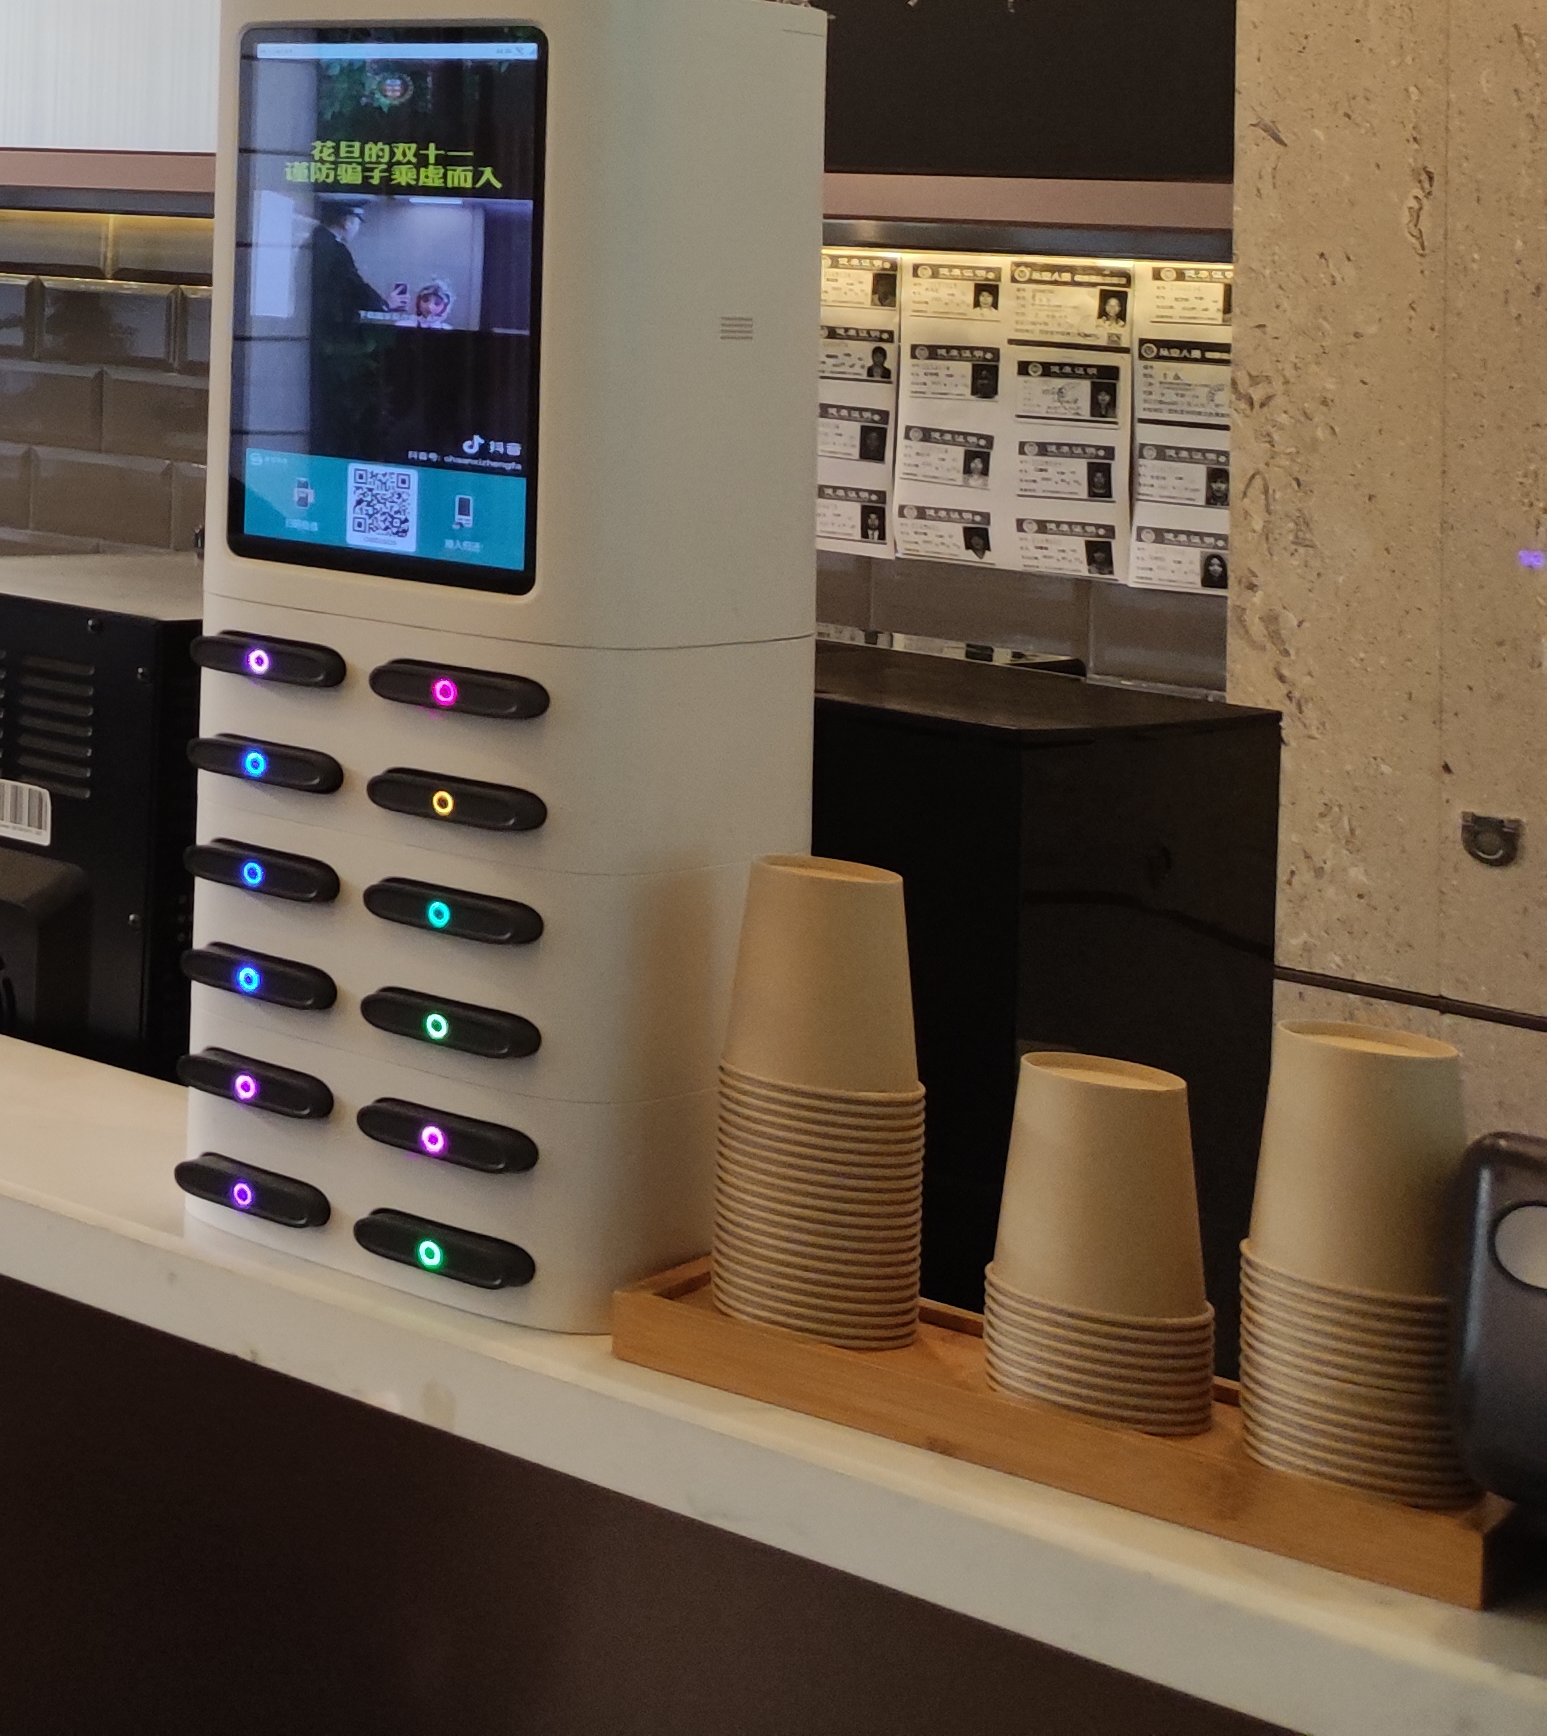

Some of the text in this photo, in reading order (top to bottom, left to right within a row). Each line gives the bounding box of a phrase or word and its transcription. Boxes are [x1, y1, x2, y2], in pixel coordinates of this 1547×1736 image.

[311, 140, 474, 164] 花旦的双十一
[284, 161, 502, 189] 谨防骗子乘虚而入
